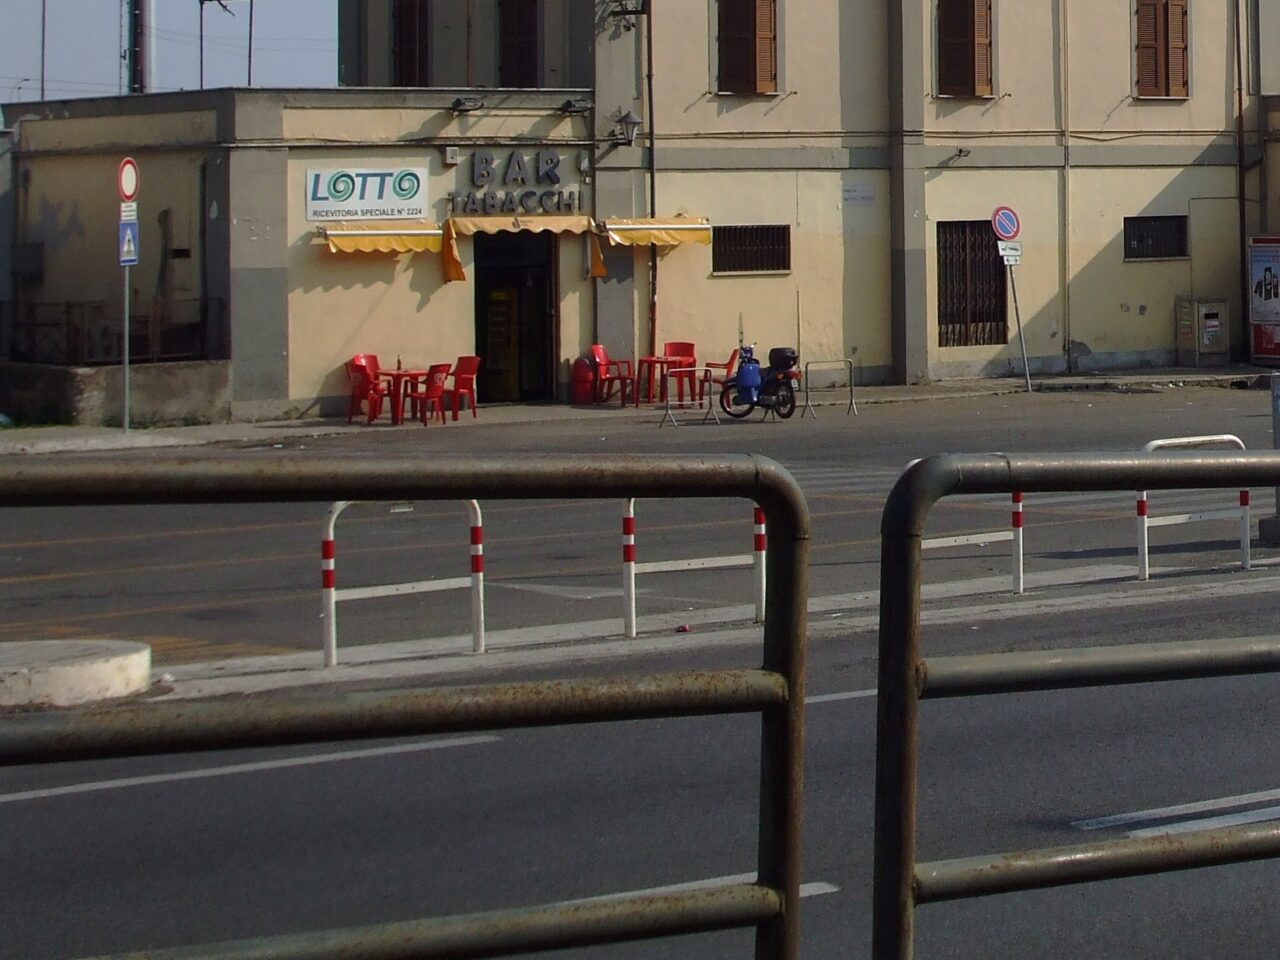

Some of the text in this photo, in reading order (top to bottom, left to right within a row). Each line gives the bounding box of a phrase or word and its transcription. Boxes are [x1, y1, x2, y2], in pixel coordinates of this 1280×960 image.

[471, 149, 560, 186] BAR
[311, 170, 420, 202] LOTTO
[313, 209, 359, 218] RICEVITORIA
[361, 208, 396, 217] SPECIALE
[448, 191, 585, 214] TABACCHI
